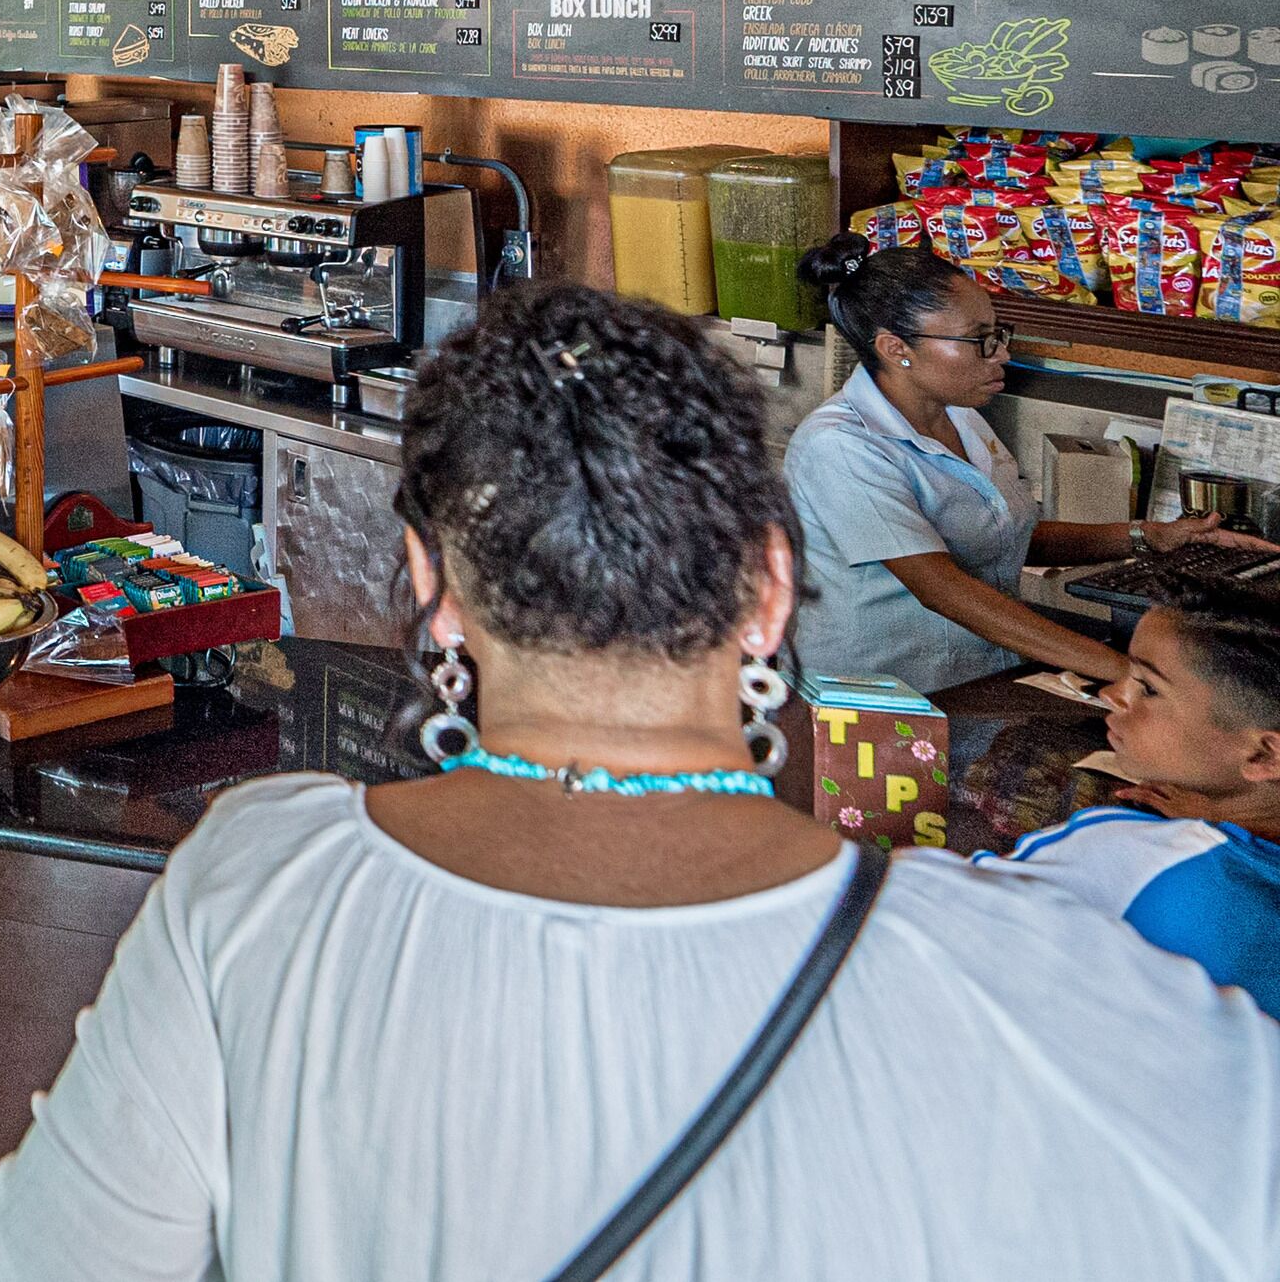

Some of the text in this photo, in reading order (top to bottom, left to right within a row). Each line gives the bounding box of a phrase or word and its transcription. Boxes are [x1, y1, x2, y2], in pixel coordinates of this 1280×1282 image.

[743, 5, 773, 21] GREEK
[914, 6, 949, 25] $139
[527, 22, 572, 37] BOX LUNCH
[650, 23, 678, 40] $299
[743, 23, 785, 36] ENSALADA
[790, 23, 820, 36] GRIEGA
[743, 37, 789, 52] ADDITIONS
[807, 38, 859, 54] ADICIONES
[884, 36, 914, 55] $79
[884, 58, 915, 76] $119
[884, 79, 914, 98] $89
